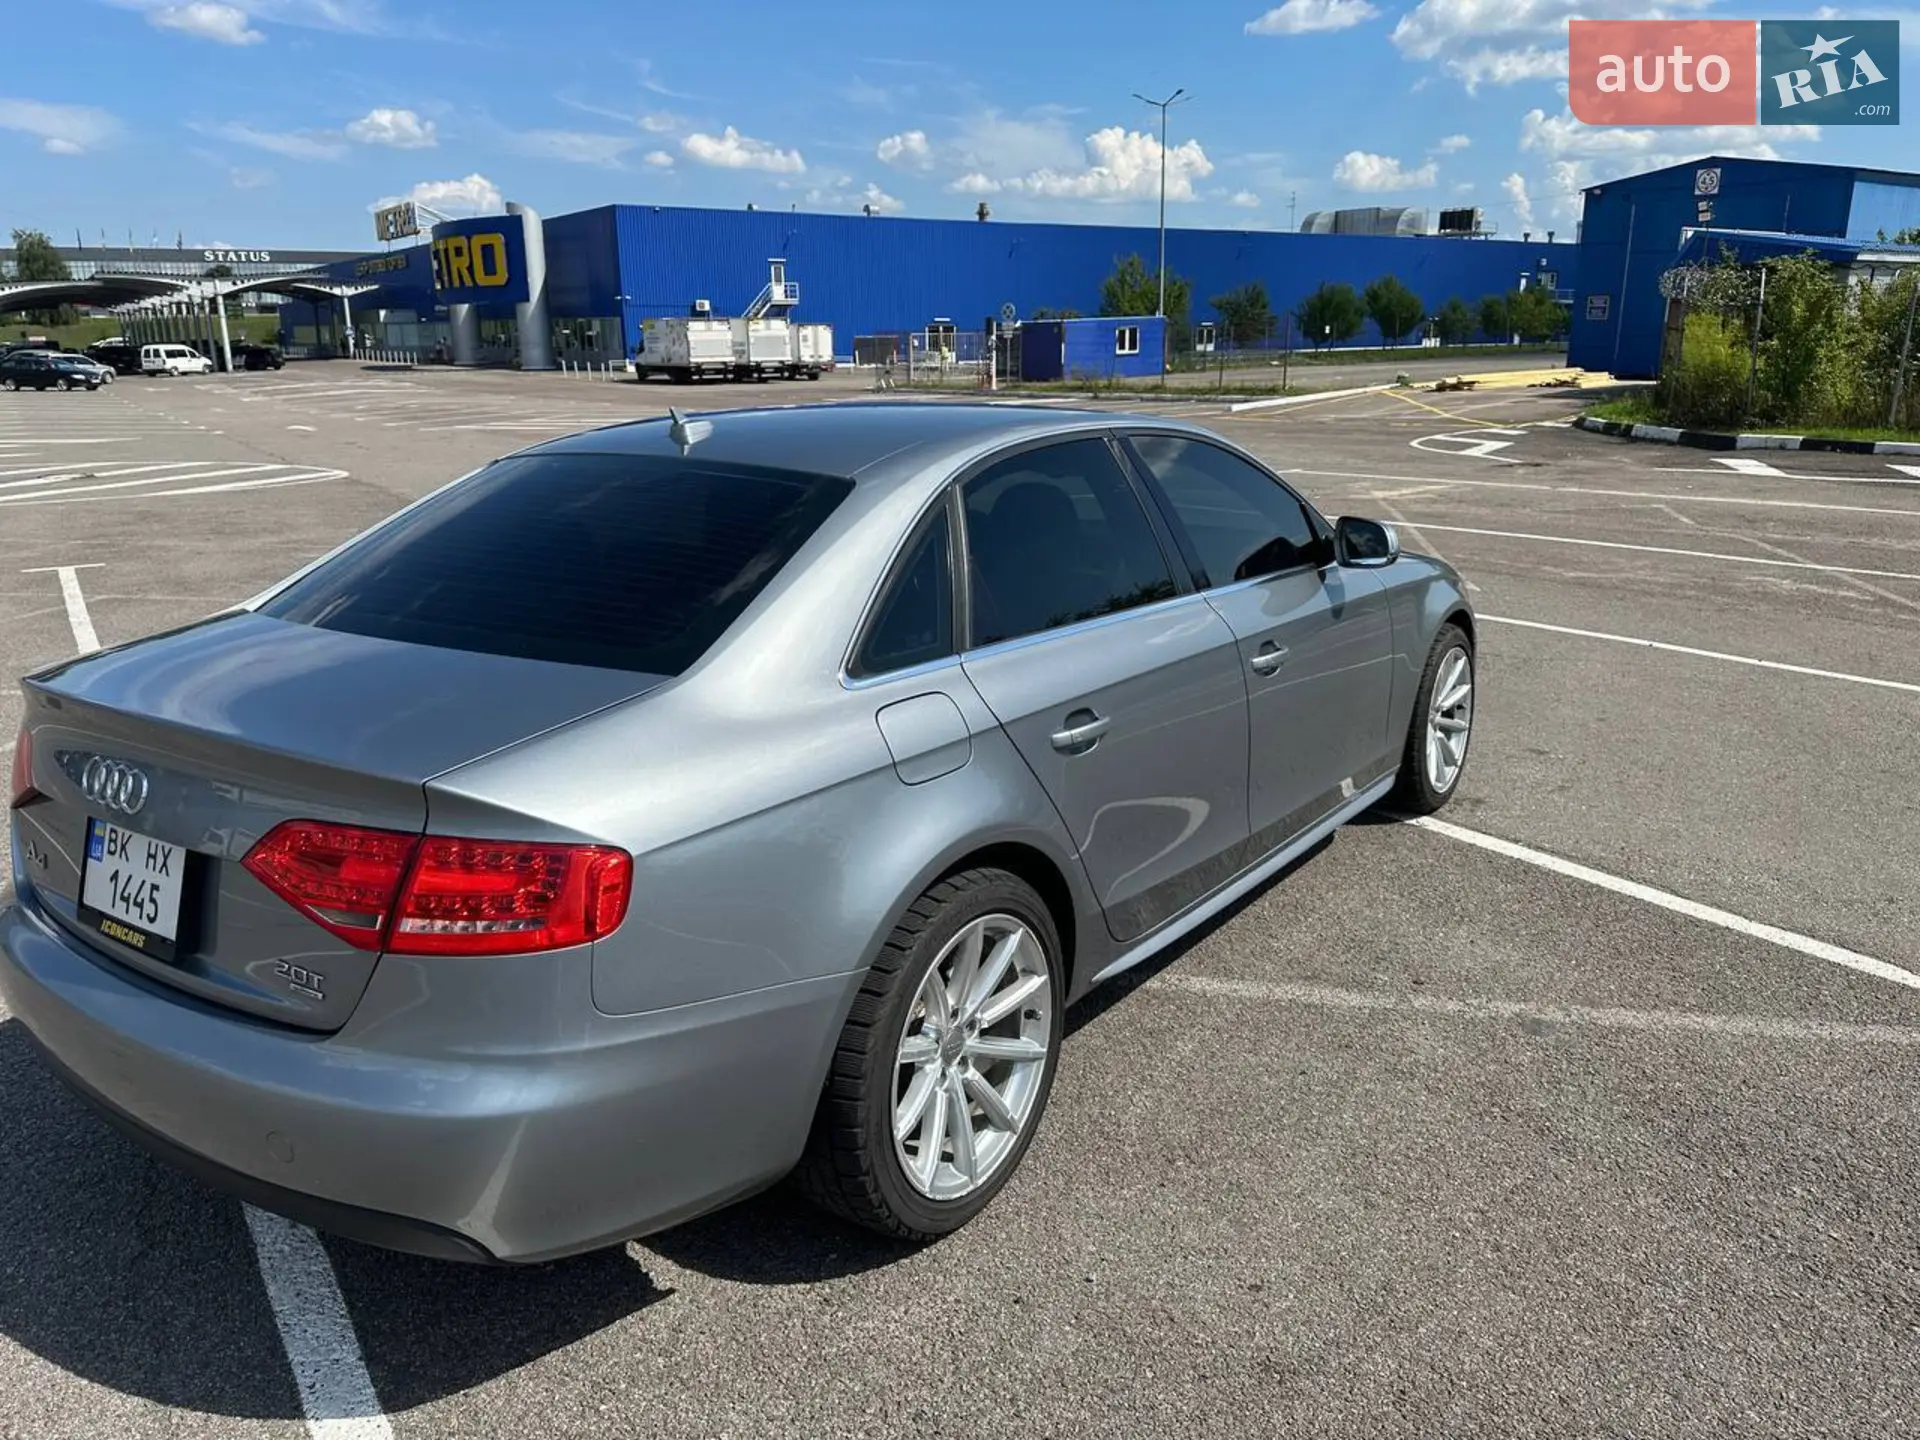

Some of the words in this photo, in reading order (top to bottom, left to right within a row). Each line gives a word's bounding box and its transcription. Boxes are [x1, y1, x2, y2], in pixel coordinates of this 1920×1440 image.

[203, 250, 271, 262] STATUS
[107, 827, 133, 863] BK
[145, 840, 173, 877] HX
[109, 868, 160, 924] 1445
[101, 919, 146, 948] ICONCARS
